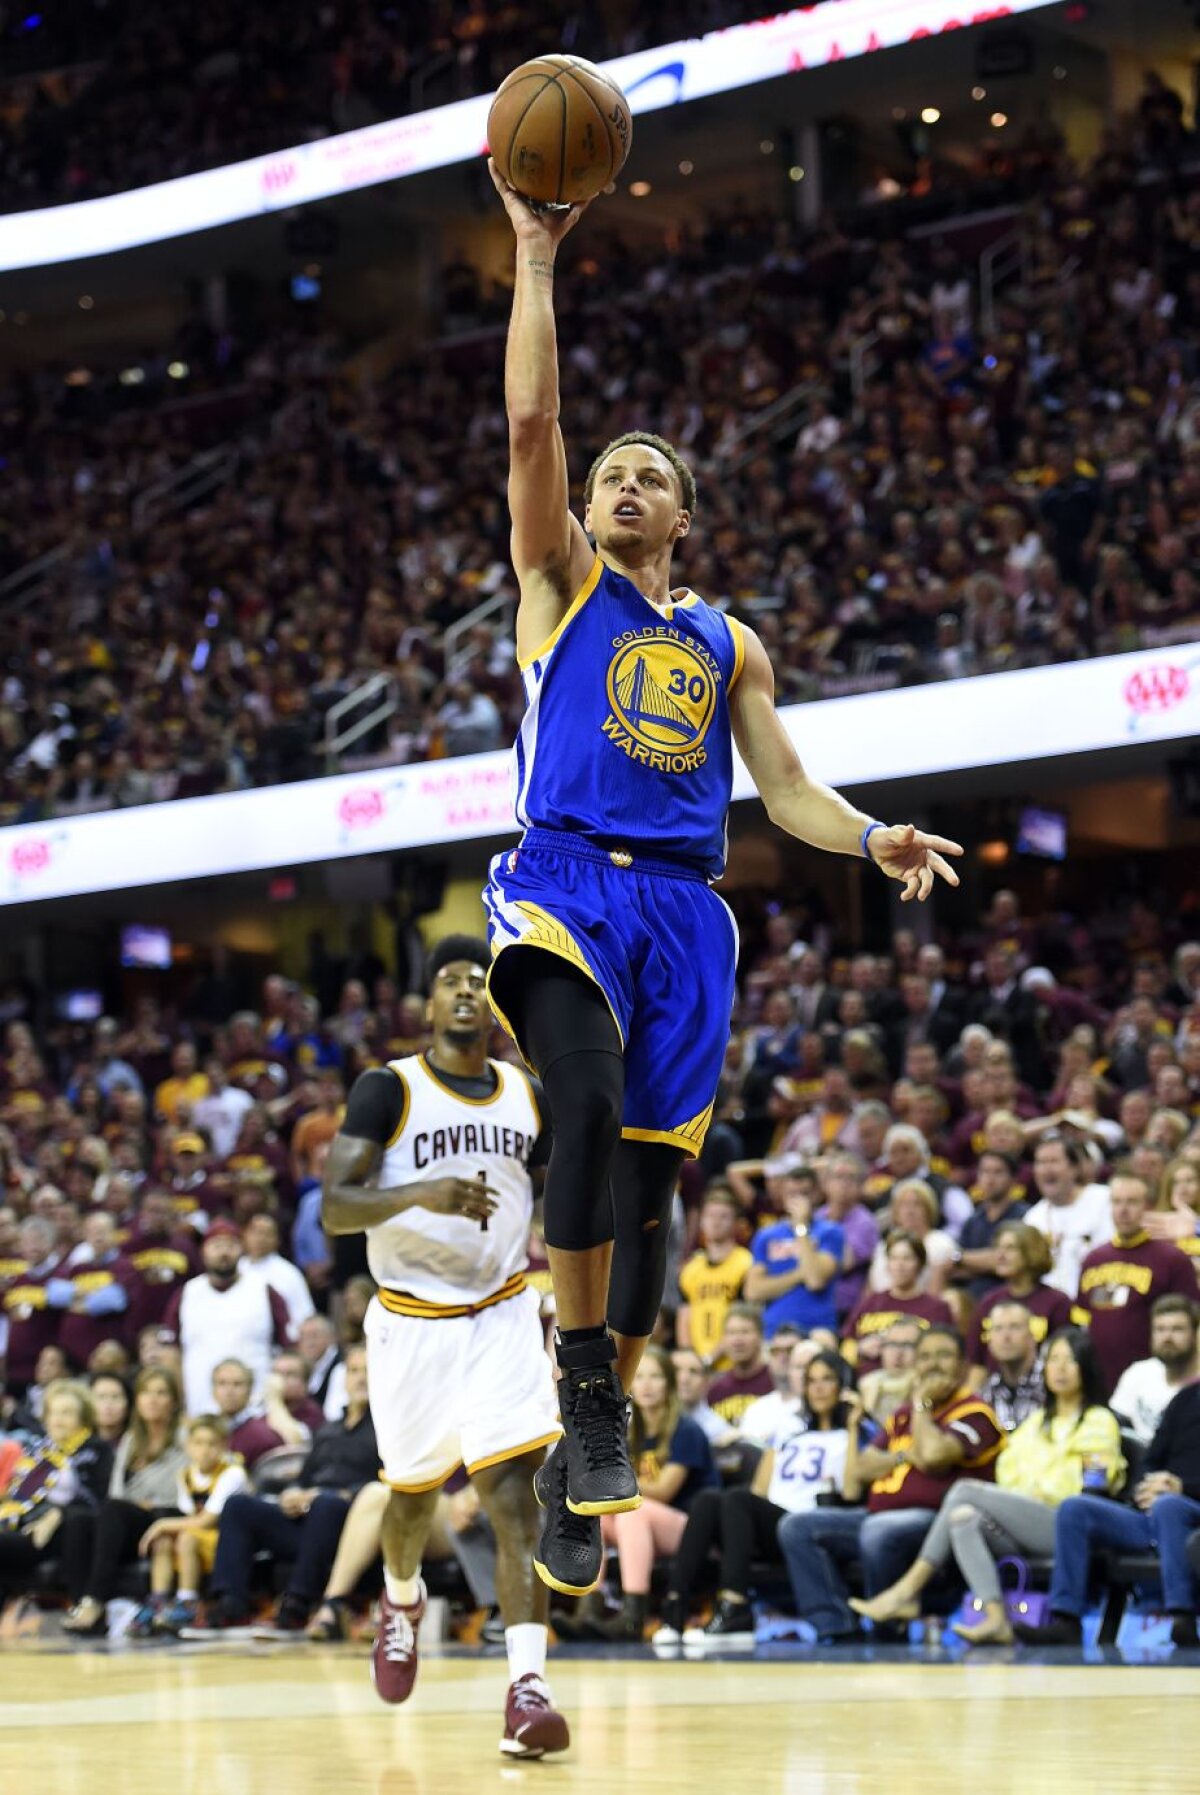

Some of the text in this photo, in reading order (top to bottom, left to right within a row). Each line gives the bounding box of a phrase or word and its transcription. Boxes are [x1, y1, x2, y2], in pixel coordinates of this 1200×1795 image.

[611, 625, 722, 682] GOLDEN STATE
[667, 668, 706, 704] 30
[601, 713, 708, 774] WARRIORS
[781, 1444, 826, 1481] 23
